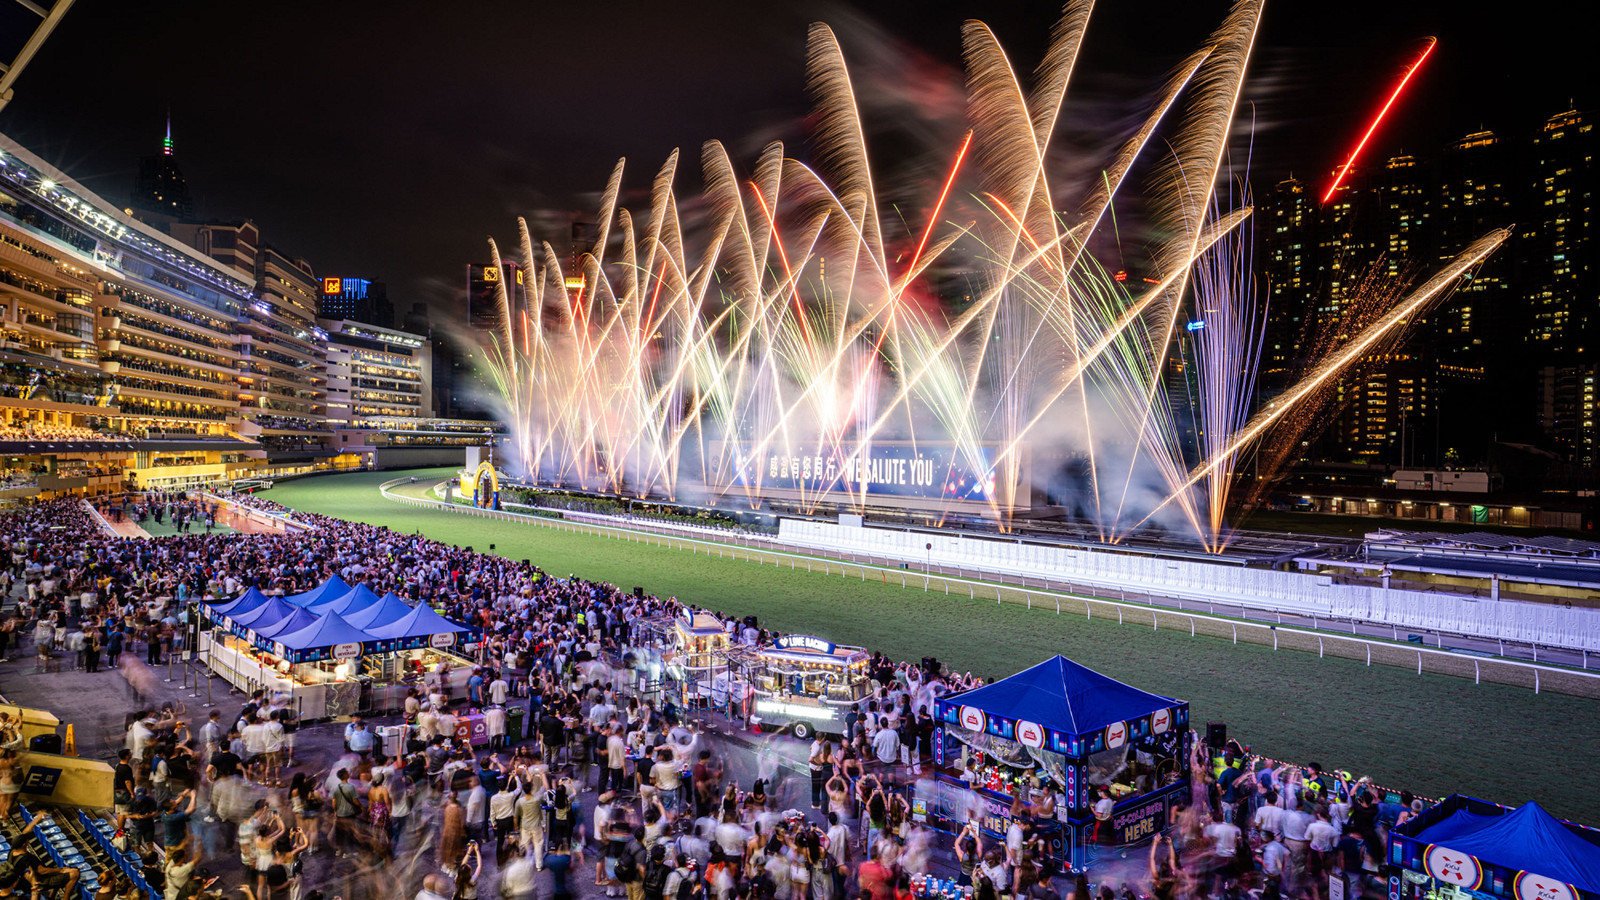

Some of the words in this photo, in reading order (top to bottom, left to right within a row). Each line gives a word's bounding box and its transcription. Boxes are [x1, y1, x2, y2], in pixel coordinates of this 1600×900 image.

[846, 457, 862, 482] WE
[865, 458, 906, 485] SALUTE
[909, 459, 933, 486] YOU
[26, 773, 43, 787] E
[986, 801, 1010, 817] COLD
[1114, 809, 1145, 830] ICE-COLD
[1146, 801, 1163, 816] BEER
[984, 815, 1012, 834] HER
[1125, 816, 1154, 843] HERE
